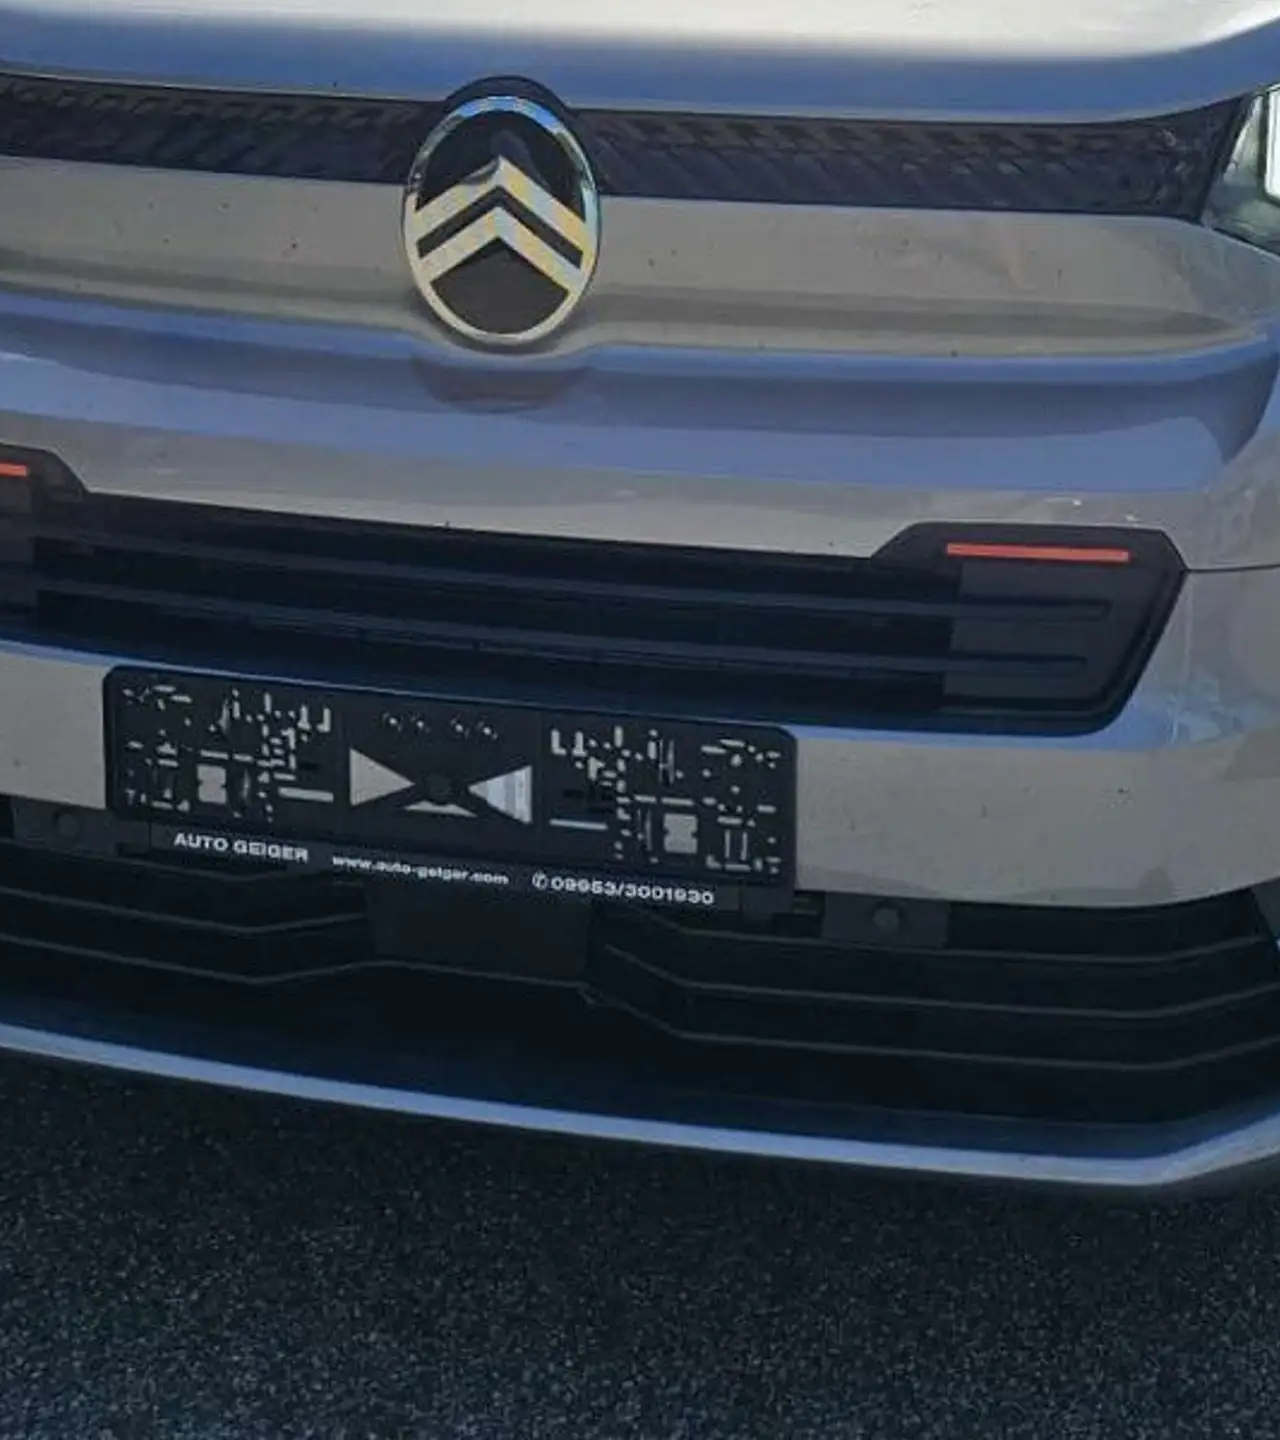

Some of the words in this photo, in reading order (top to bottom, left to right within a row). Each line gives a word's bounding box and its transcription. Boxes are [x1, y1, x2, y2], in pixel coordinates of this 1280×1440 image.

[174, 832, 228, 852] AUTO
[233, 839, 308, 863] GEIGER
[332, 856, 509, 885] www.auto-geiger.com
